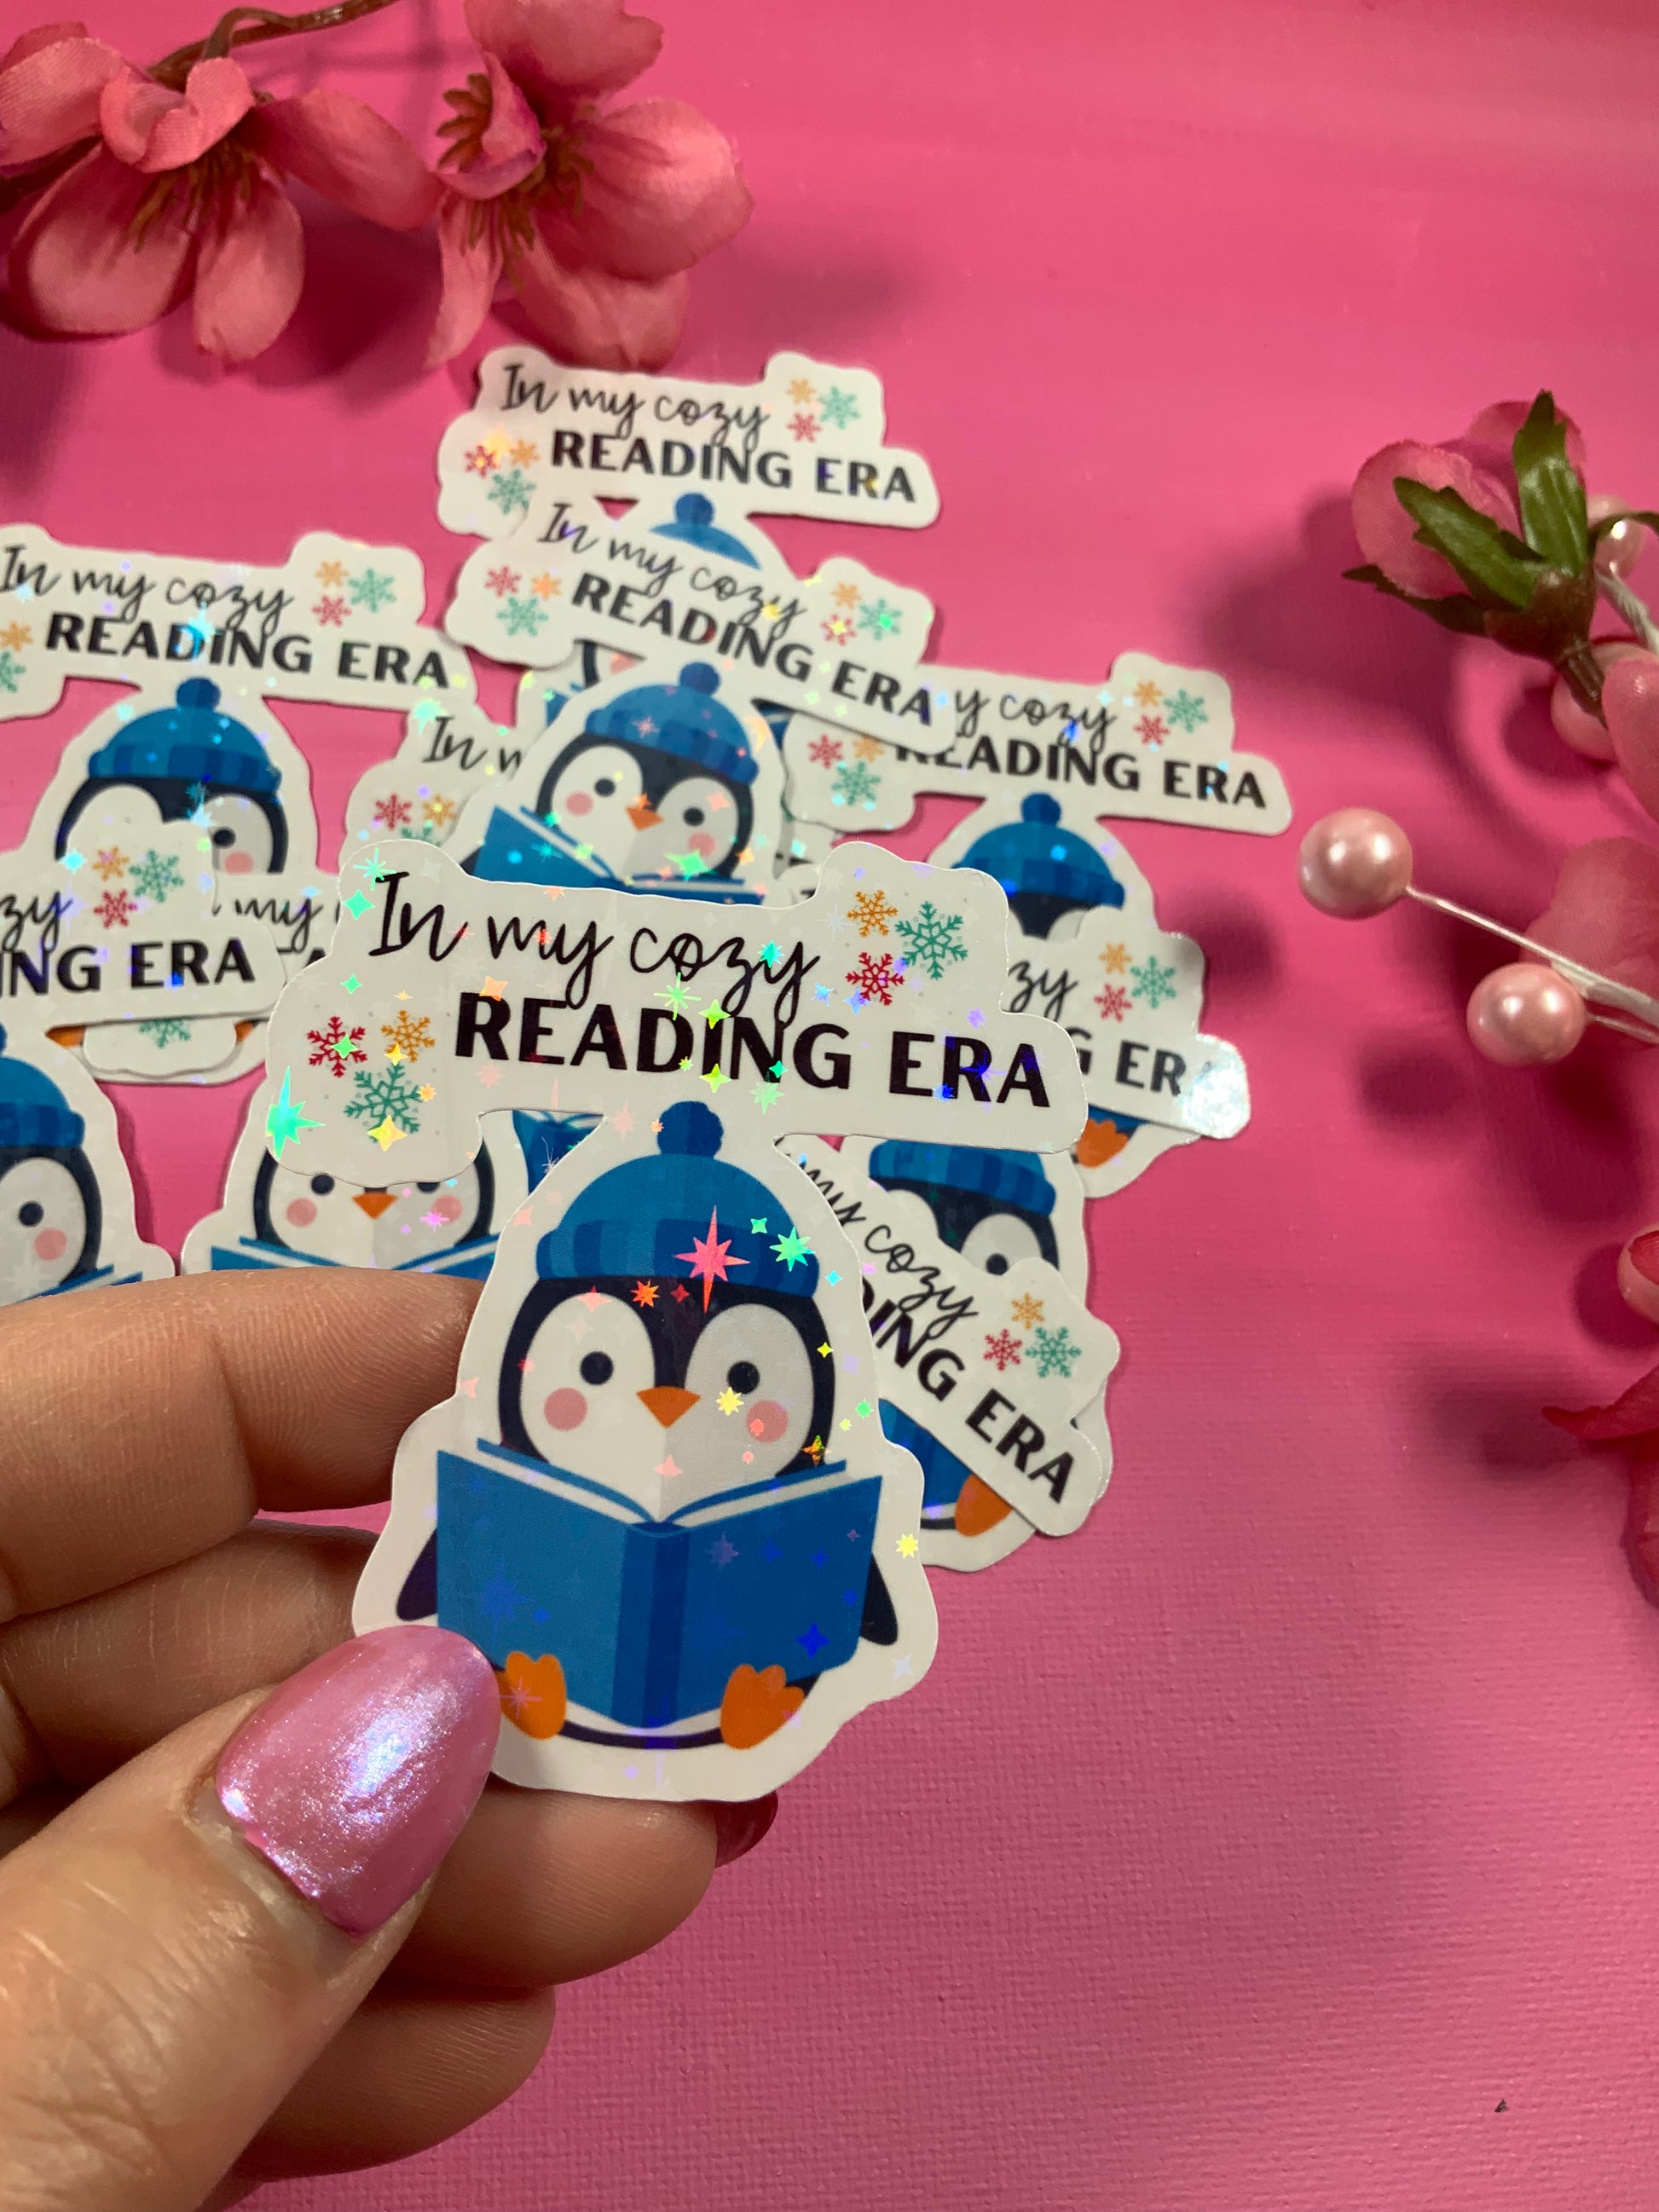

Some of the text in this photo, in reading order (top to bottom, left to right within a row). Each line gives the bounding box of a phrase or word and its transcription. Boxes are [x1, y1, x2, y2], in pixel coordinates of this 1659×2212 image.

[500, 362, 771, 451] In my cozy
[551, 429, 917, 504] READING ERA
[0, 544, 295, 637] In my cozy
[537, 502, 809, 639] In my cozy
[45, 611, 451, 690] READING ERA
[571, 572, 934, 726] READING ERA
[421, 714, 489, 771] In
[954, 689, 1118, 755] y cozy
[1163, 759, 1267, 811] ERA
[130, 937, 257, 990] ERA
[234, 897, 324, 955] my
[368, 870, 822, 1028] In my cozy
[454, 991, 853, 1091] READING
[888, 1030, 1052, 1109] ERA
[1115, 1039, 1215, 1098] ER
[864, 1223, 980, 1340] cozy
[964, 1388, 1075, 1505] ERA
